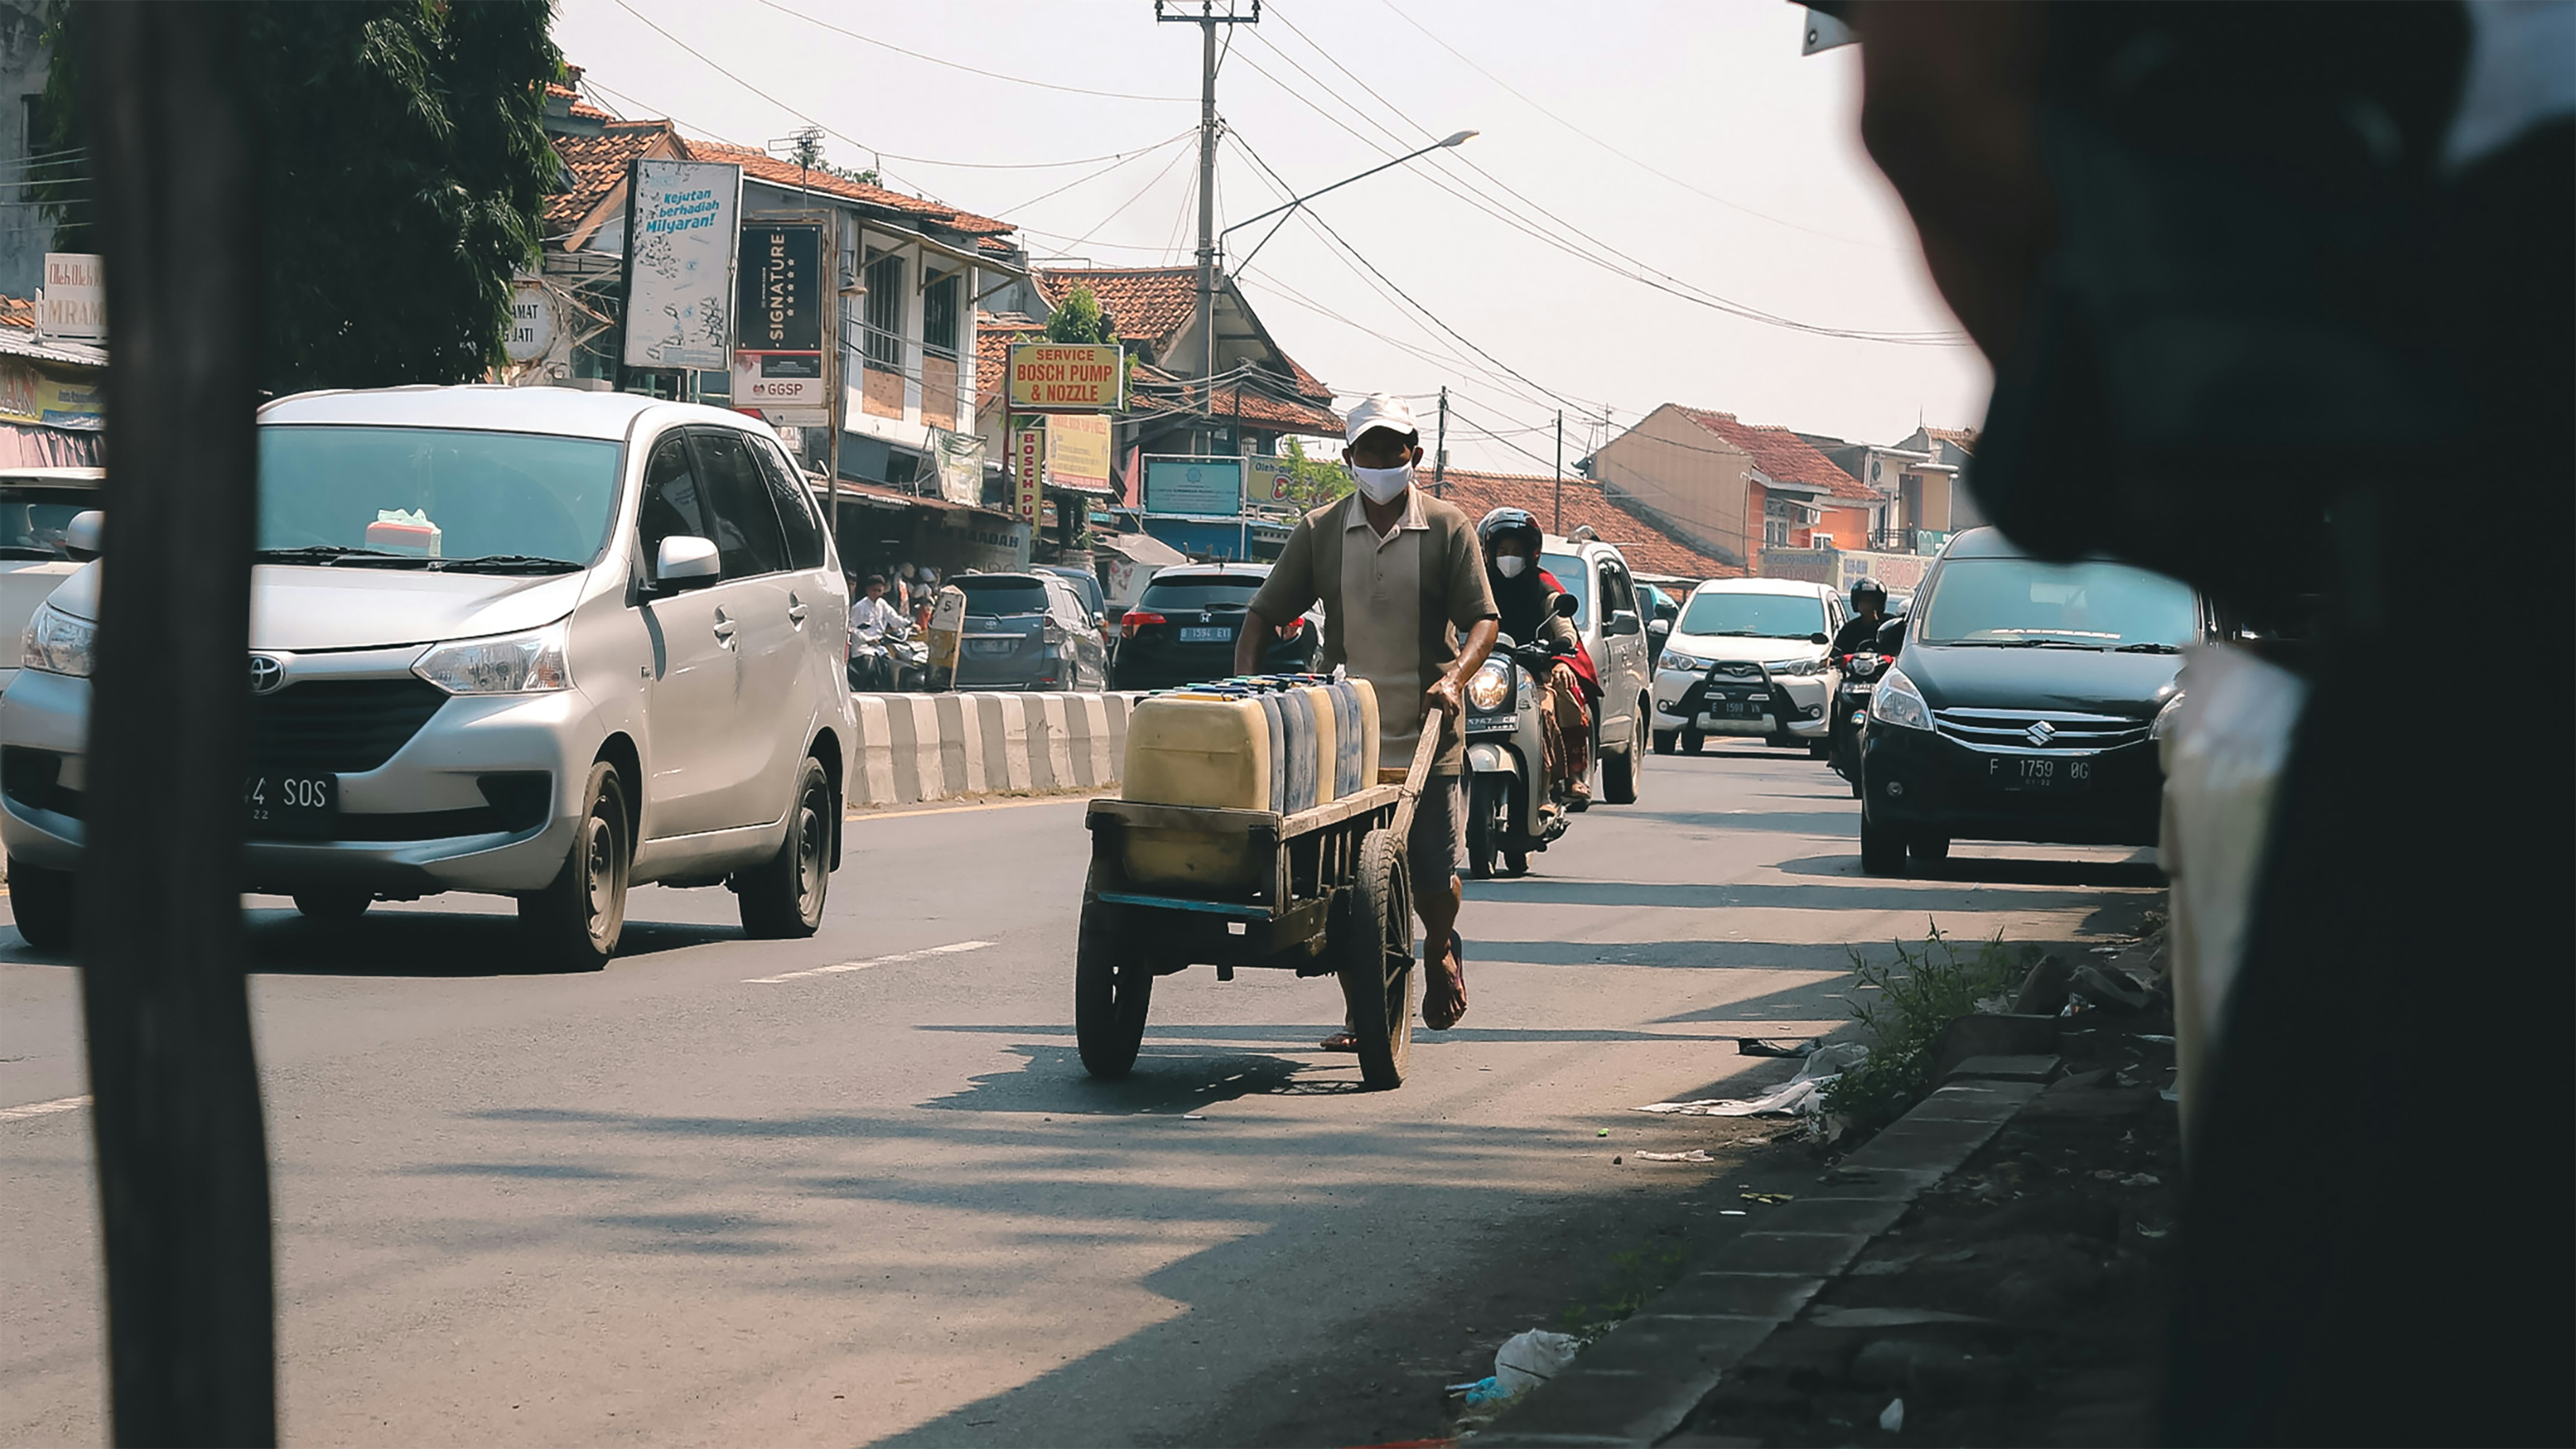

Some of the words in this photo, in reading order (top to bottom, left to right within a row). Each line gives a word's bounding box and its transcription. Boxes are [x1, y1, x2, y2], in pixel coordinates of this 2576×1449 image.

[664, 190, 711, 205] Kejutan
[659, 200, 719, 218] berhadiah
[646, 213, 716, 234] Milyaran!
[50, 263, 70, 285] Oleh
[770, 234, 784, 340] SIGNATURE
[1036, 349, 1095, 361] SERVICE
[1017, 364, 1065, 381] BOSCH
[1070, 364, 1112, 382] PUMP
[768, 384, 803, 396] GGSP
[1032, 385, 1041, 401] &
[1047, 385, 1098, 401] NOZZLE
[1023, 434, 1035, 489] BOSCH
[1991, 759, 1999, 775] F
[2020, 760, 2053, 777] 1759
[284, 779, 326, 807] SOS
